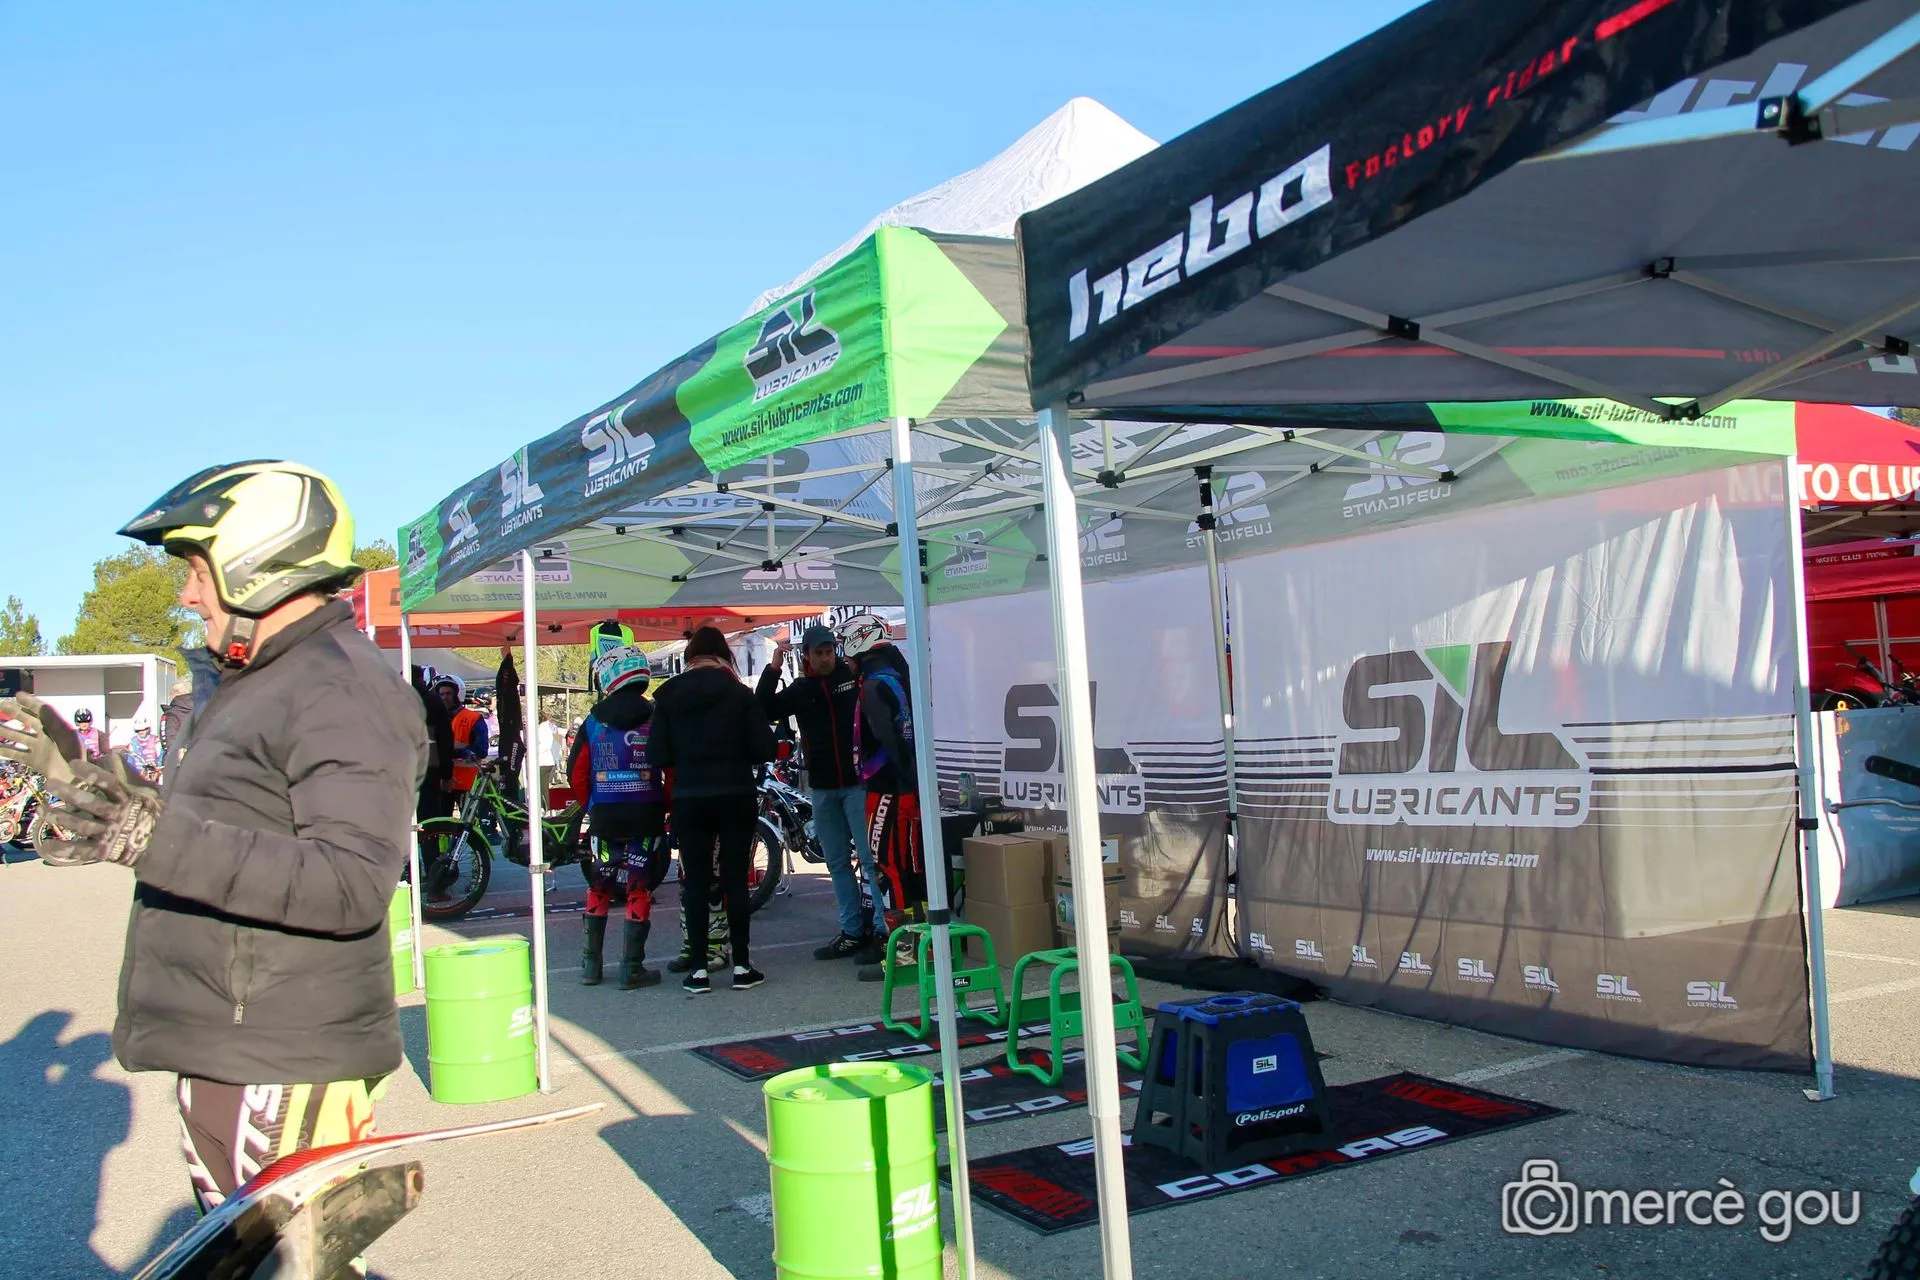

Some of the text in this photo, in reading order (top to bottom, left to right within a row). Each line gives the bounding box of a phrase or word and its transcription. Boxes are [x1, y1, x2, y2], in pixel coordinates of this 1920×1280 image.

[1068, 143, 1333, 342] hebo
[755, 351, 839, 400] LUBRICANTS
[721, 382, 864, 446] www.sil-lubricants.com
[1333, 785, 1582, 817] LUBRICANTS
[1366, 846, 1540, 868] www.sil-lubricants.com
